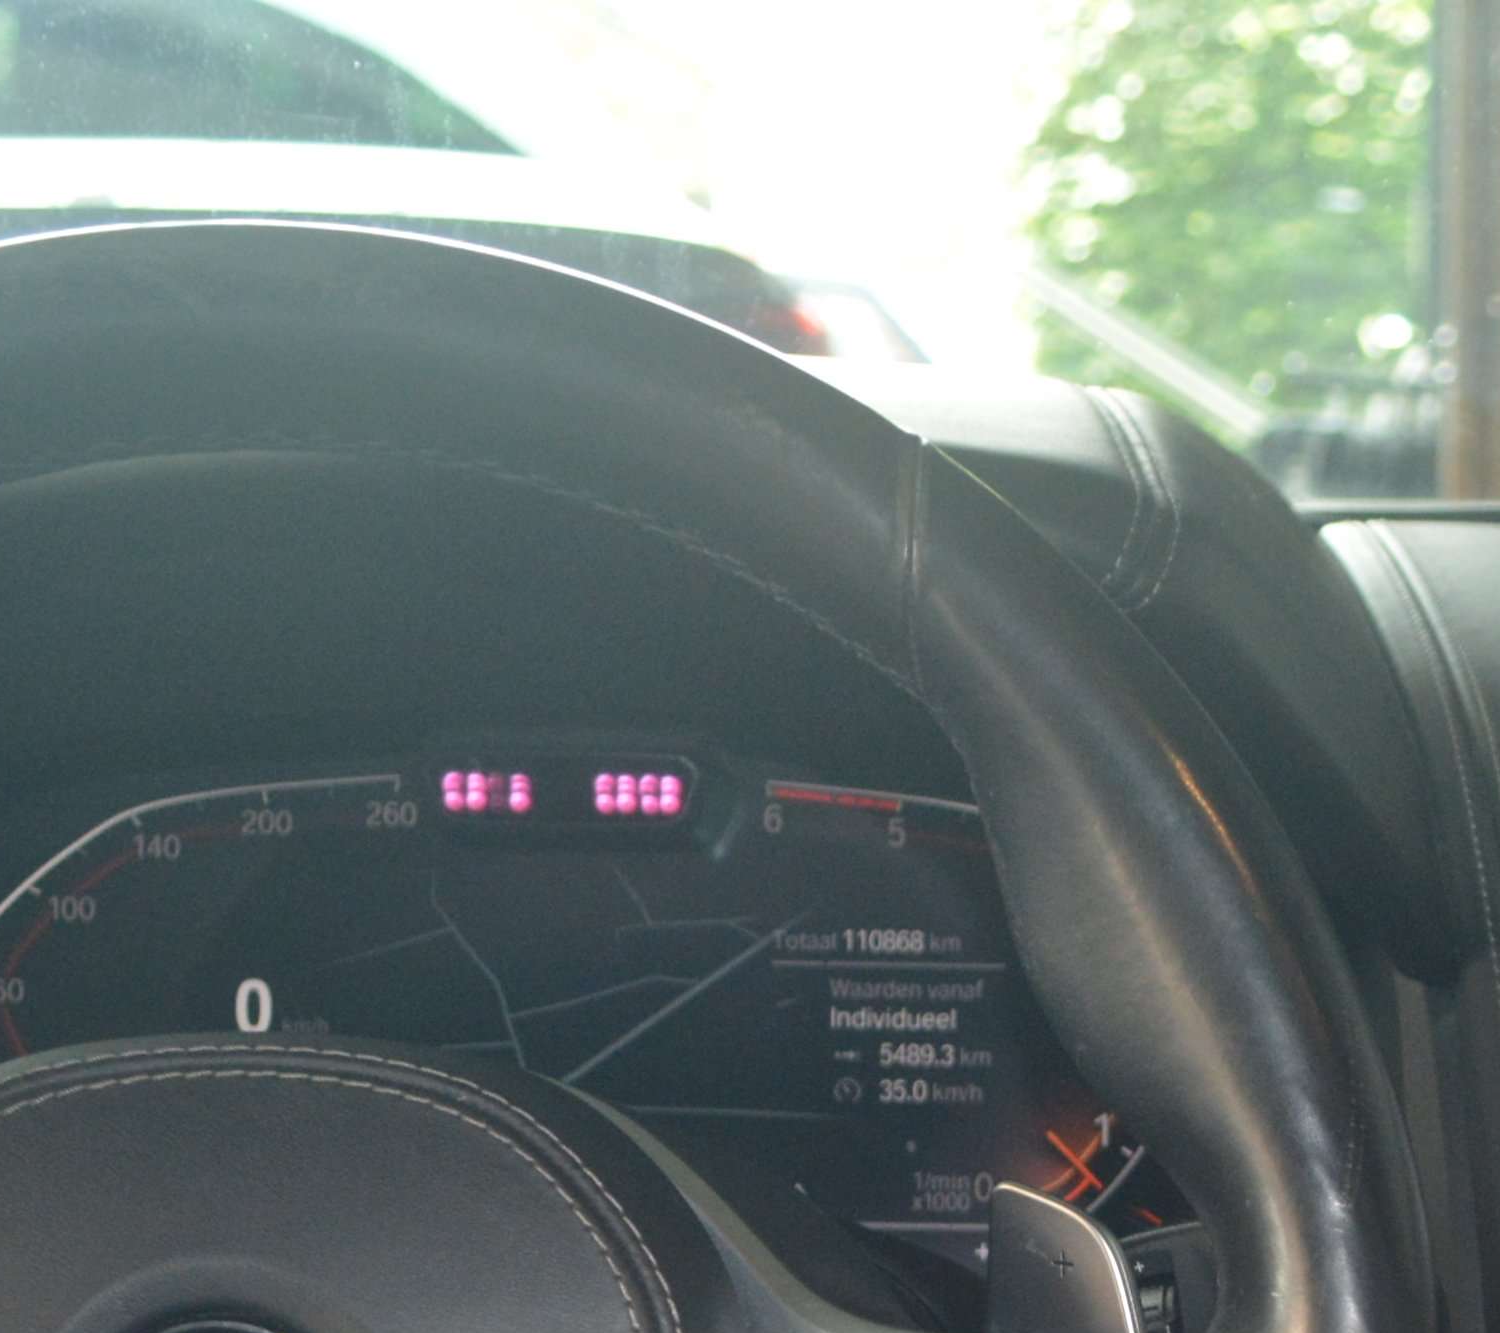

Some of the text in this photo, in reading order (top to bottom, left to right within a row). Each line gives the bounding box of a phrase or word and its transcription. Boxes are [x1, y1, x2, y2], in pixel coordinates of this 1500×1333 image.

[241, 810, 293, 835] 200
[365, 803, 417, 828] 260
[763, 807, 782, 834] 6
[888, 819, 906, 848] 5
[133, 835, 181, 860] 140
[48, 896, 95, 922] 100
[774, 929, 962, 951] Totaal 110868 km
[830, 978, 985, 999] Waarden vanaf
[235, 978, 272, 1032] 0
[830, 1006, 957, 1030] Individueel
[879, 1042, 992, 1067] 5489.3 km
[879, 1078, 984, 1102] 35.0 km/h
